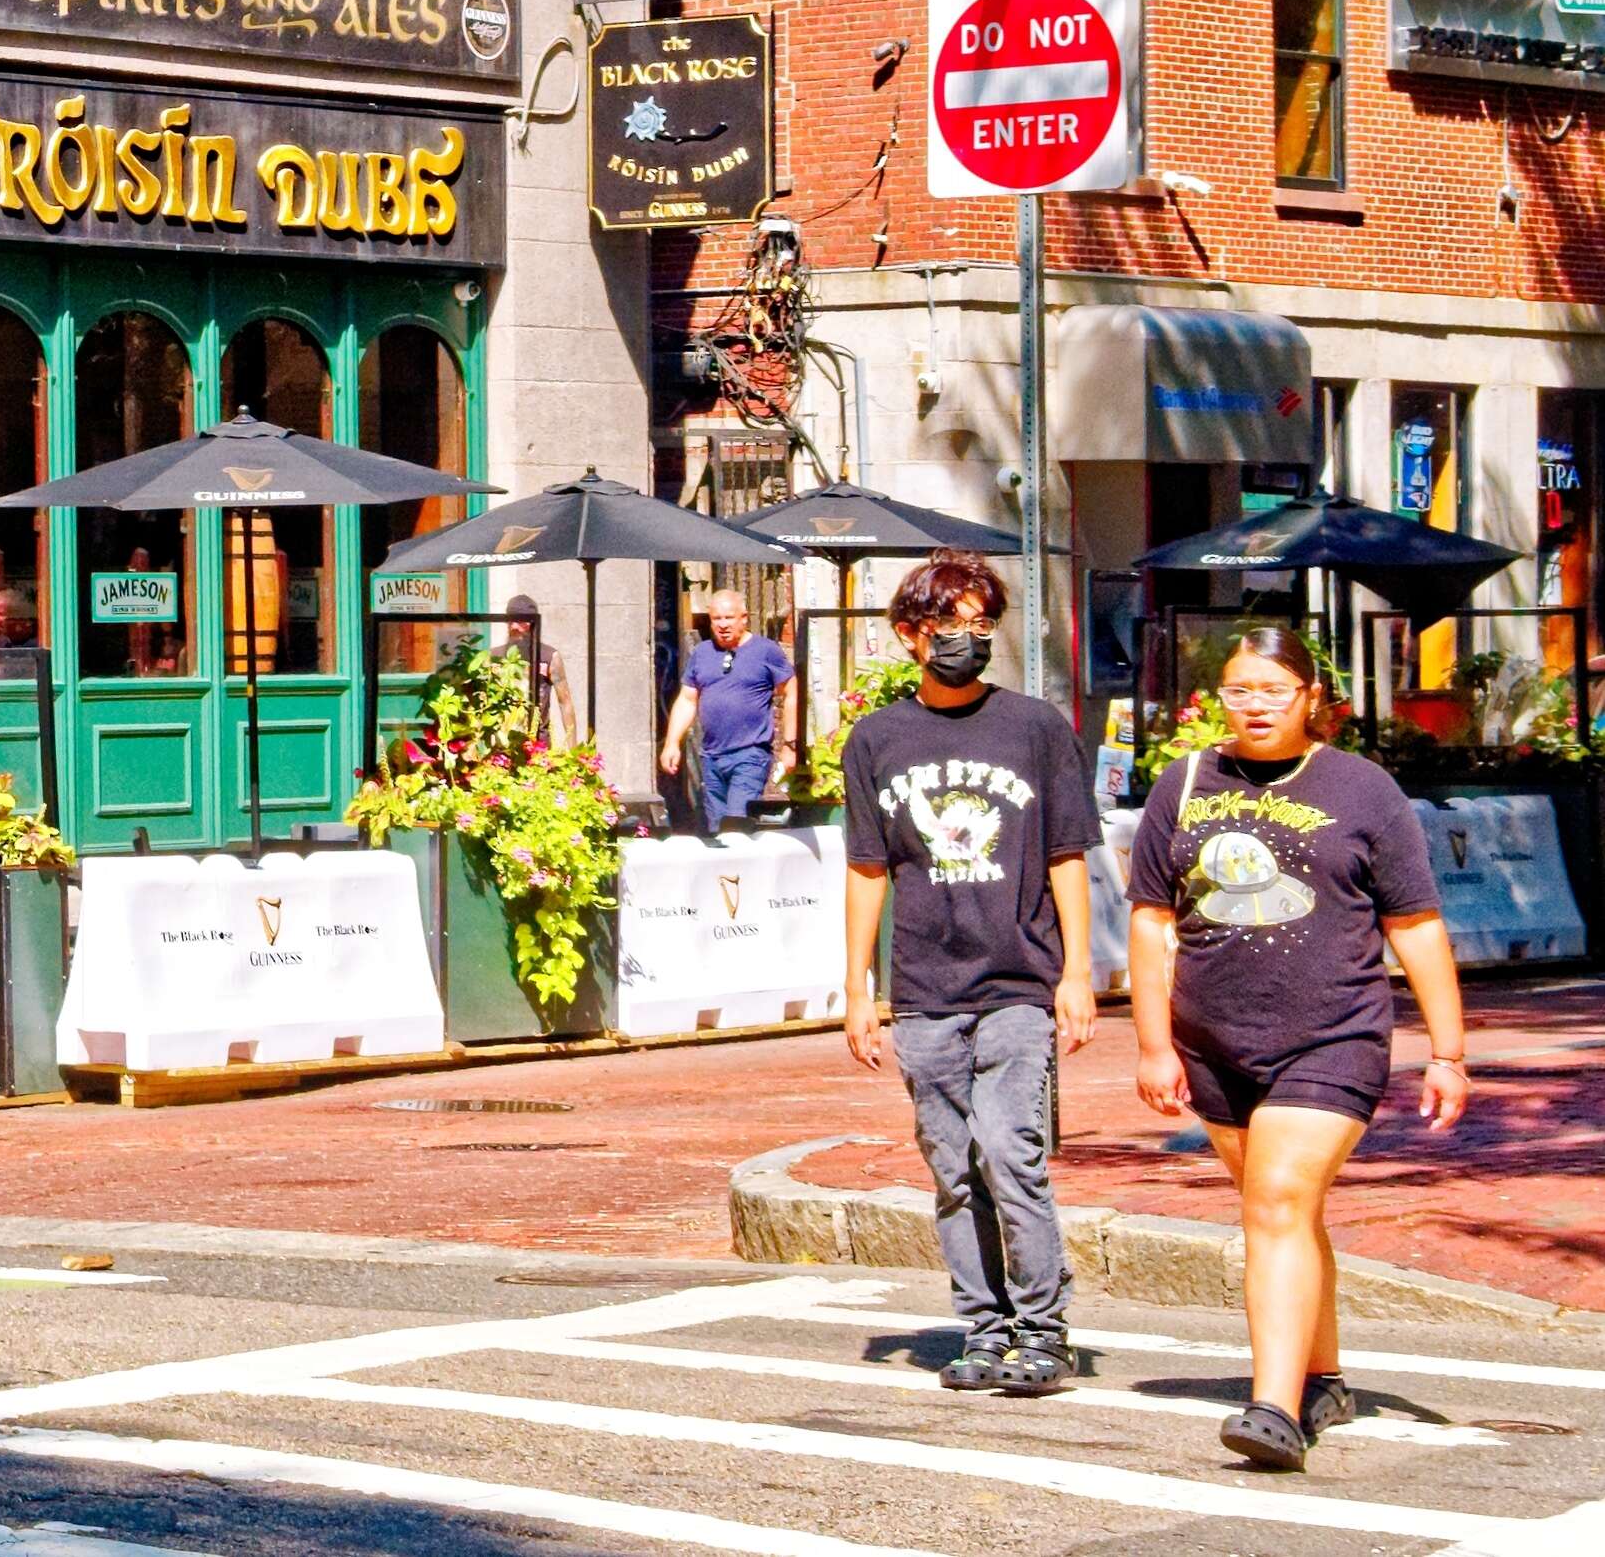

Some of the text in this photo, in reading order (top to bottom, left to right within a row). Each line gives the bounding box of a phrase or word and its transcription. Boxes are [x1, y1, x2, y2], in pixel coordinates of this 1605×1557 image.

[960, 14, 1091, 55] DO NOT
[600, 56, 757, 87] BLACK ROSE
[973, 113, 1079, 150] ENTER
[691, 147, 750, 182] DUBH
[648, 202, 707, 219] GUINNESS
[1537, 462, 1582, 490] LTRA
[194, 490, 306, 502] GUINNESS
[777, 534, 878, 544] GUINNESS
[100, 578, 169, 605] JAMESON
[378, 578, 441, 605] JAMESON
[713, 924, 760, 940] GUINNESS
[250, 950, 304, 967] GUINNESS
